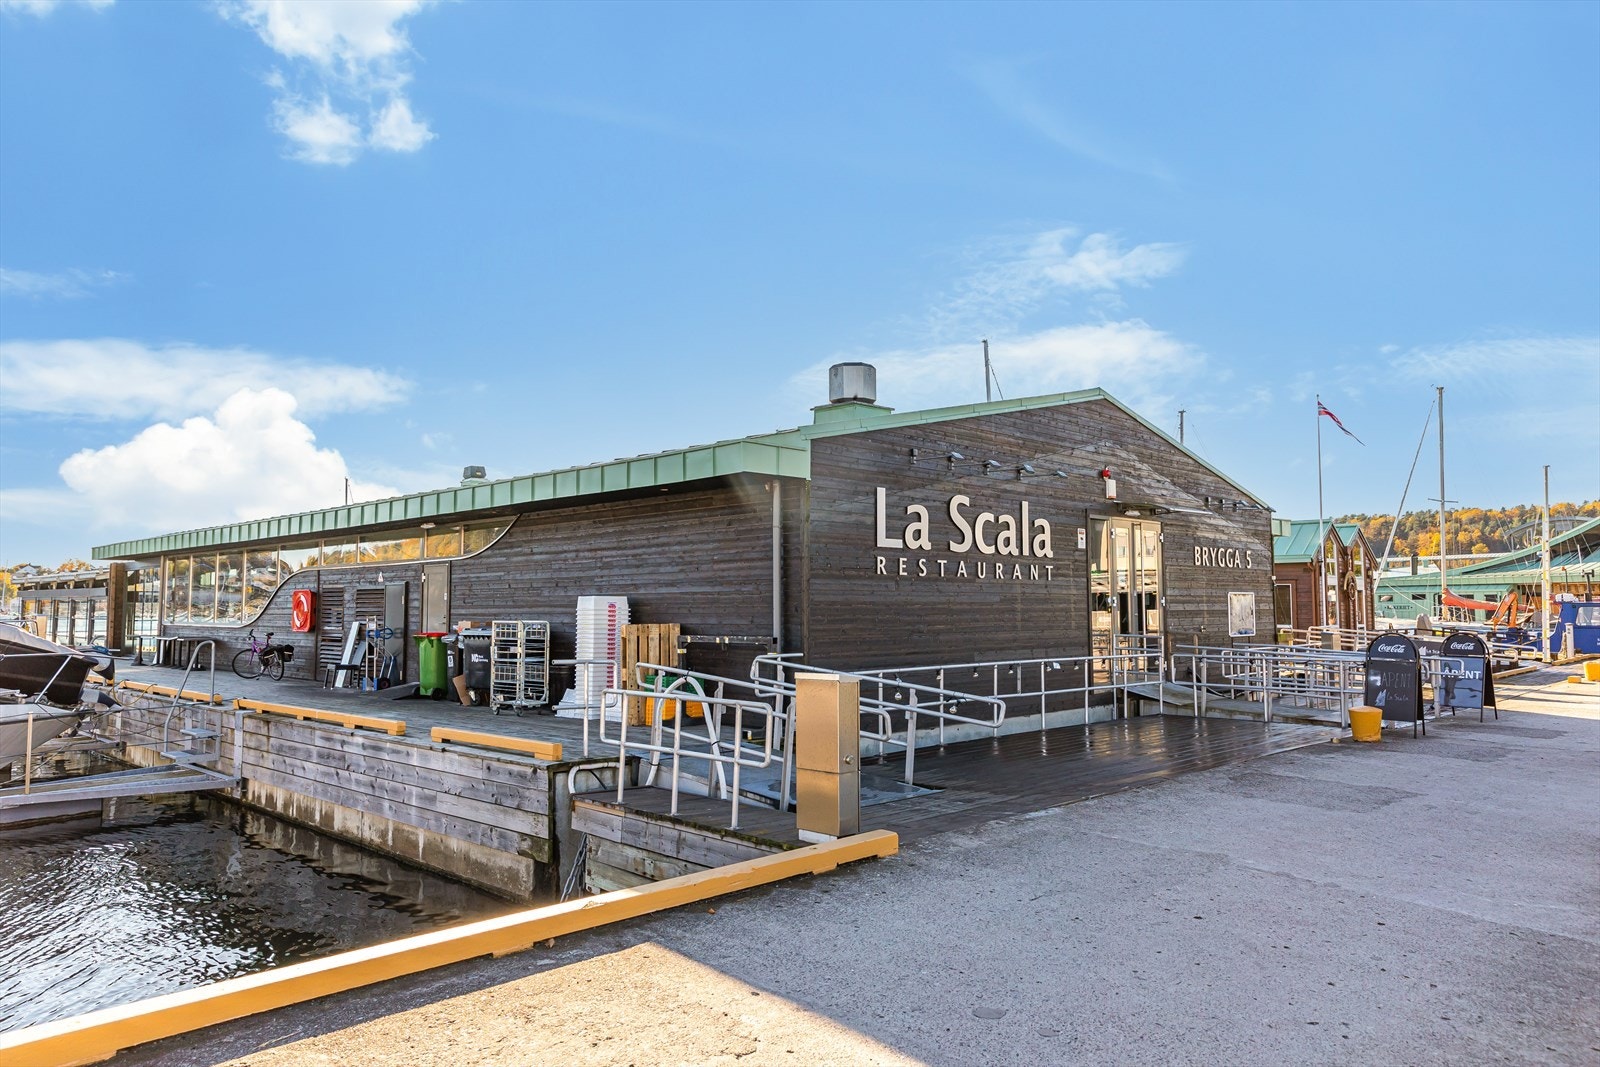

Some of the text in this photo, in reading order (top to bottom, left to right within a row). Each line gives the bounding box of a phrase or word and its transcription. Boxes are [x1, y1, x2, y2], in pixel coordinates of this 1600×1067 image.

[876, 486, 1054, 558] La Scala
[876, 555, 1054, 581] RESTAURANT
[1194, 545, 1252, 569] BRYGGA 5
